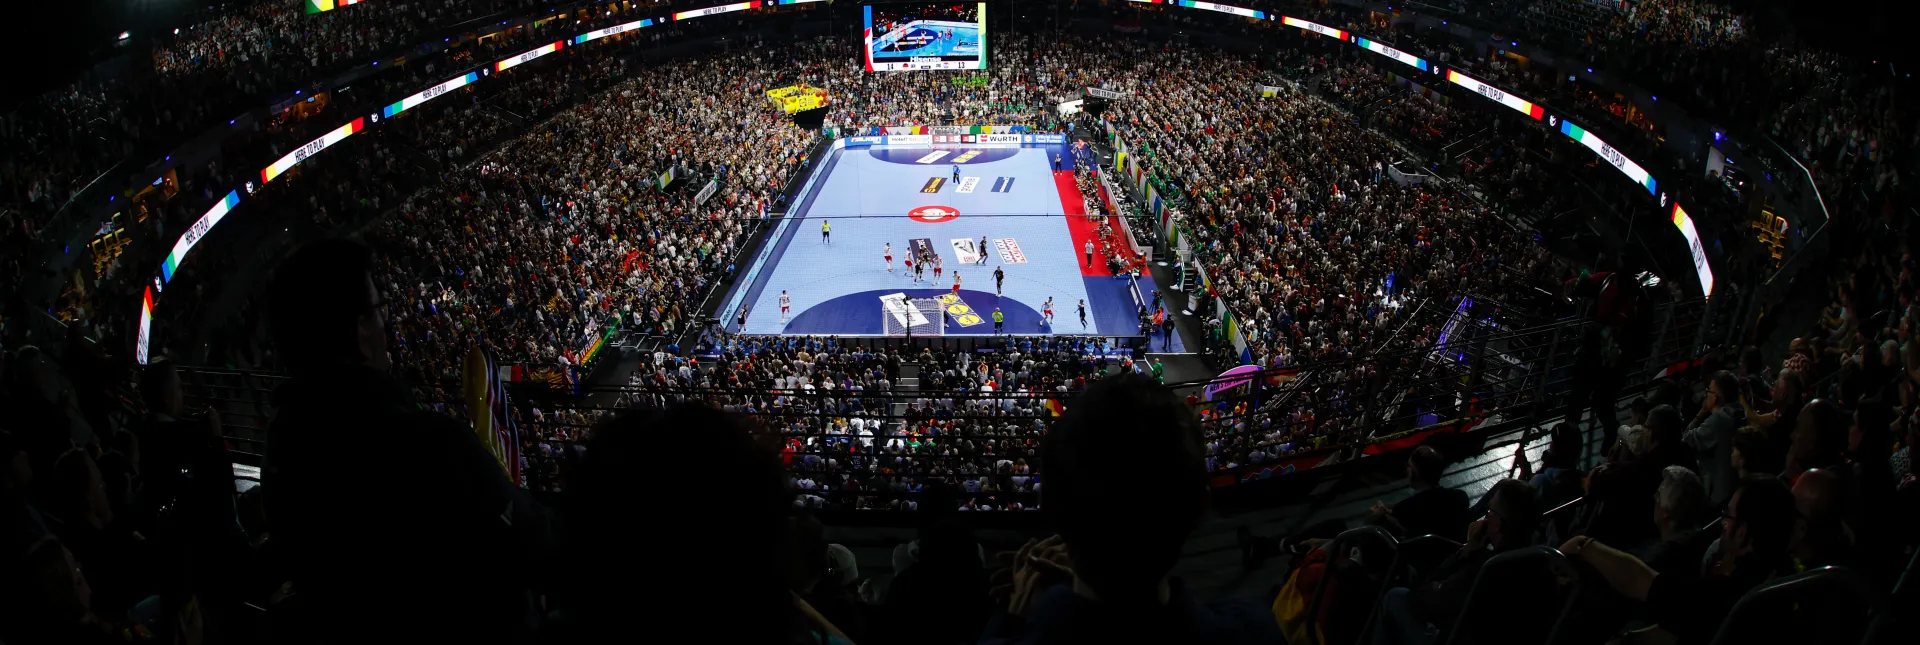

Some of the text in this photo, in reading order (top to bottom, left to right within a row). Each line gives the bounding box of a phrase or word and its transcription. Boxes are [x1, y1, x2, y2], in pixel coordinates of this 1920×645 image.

[423, 89, 432, 100] HERE
[437, 84, 447, 94] PLAY
[1478, 84, 1488, 96] HERE
[1493, 90, 1504, 102] PLAY
[295, 138, 325, 162] HERE TO PLAY
[1601, 142, 1611, 158] HERE
[1615, 153, 1626, 170] PLAY
[185, 227, 196, 246] HERE
[200, 215, 211, 235] PLAY
